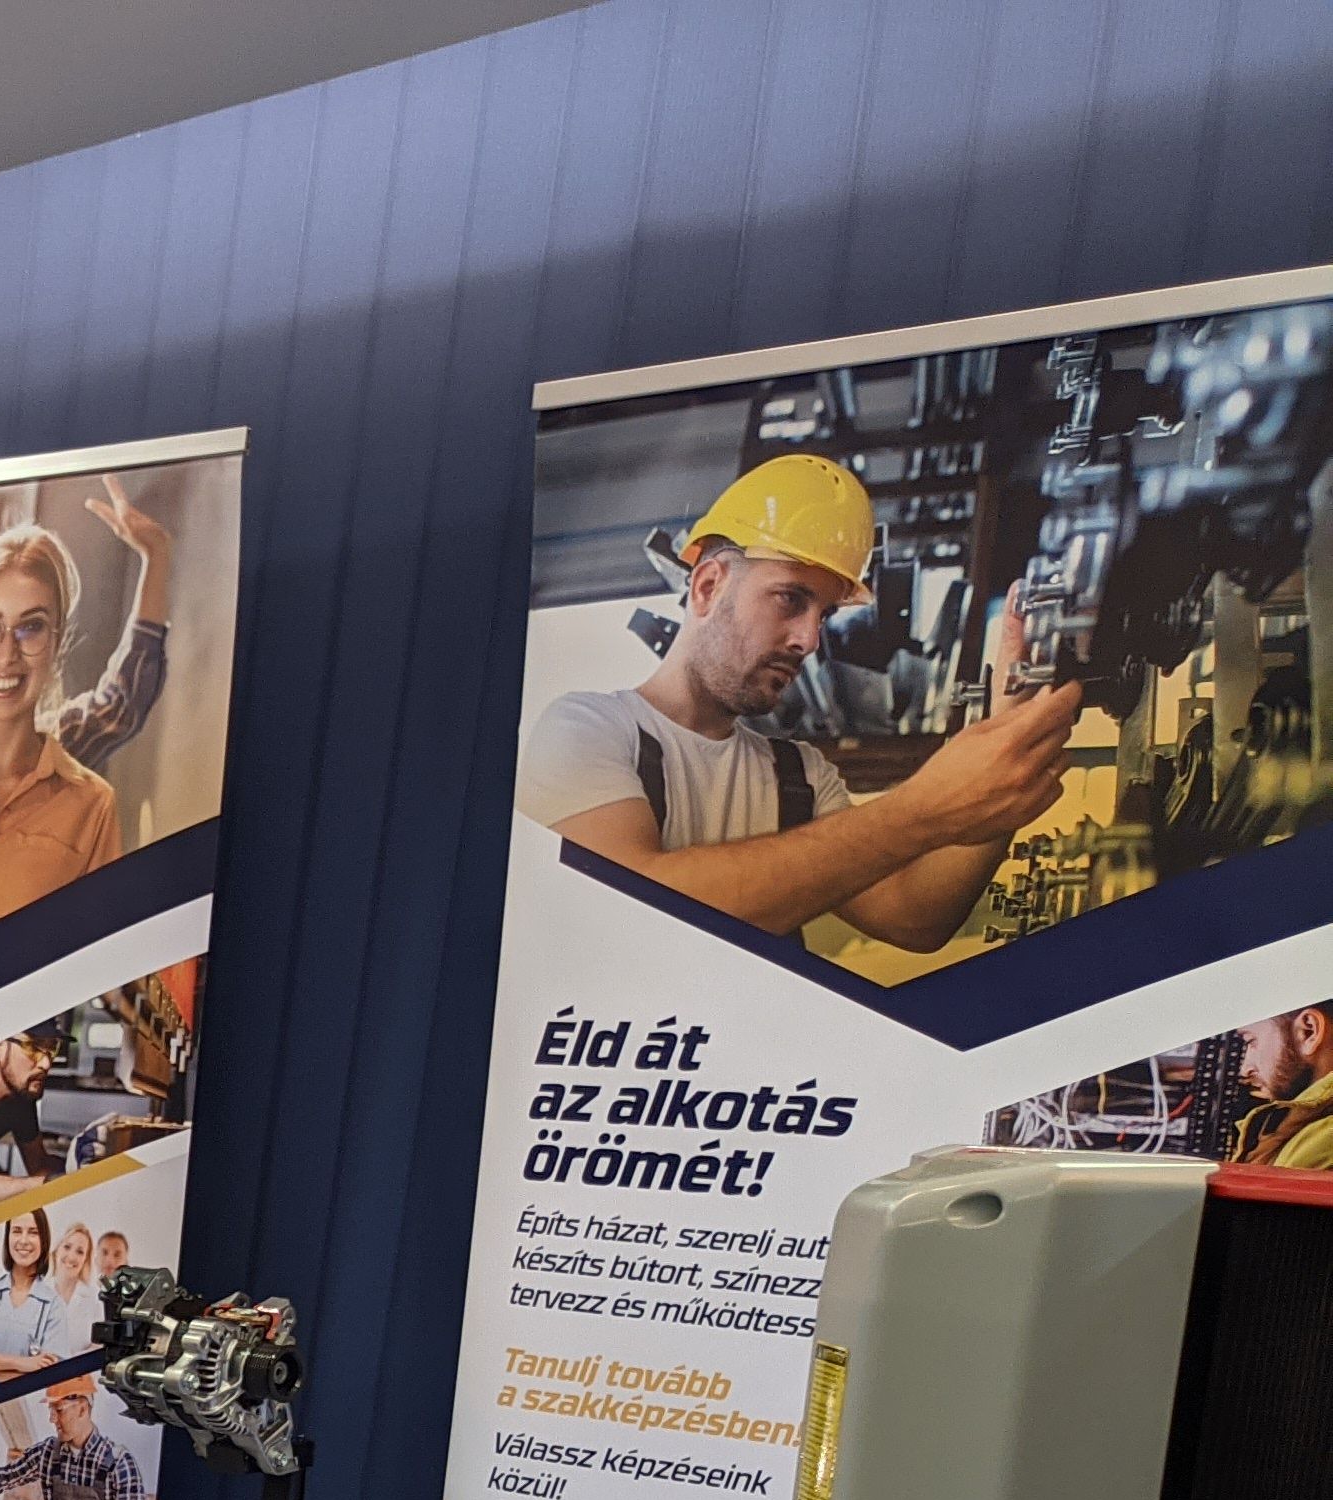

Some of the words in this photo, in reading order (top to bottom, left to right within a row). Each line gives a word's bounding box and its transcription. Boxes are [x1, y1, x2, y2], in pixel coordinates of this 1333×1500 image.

[535, 1005, 632, 1069] Éld
[634, 1016, 709, 1071] át
[528, 1083, 601, 1122] az
[607, 1078, 858, 1137] alkotás
[522, 1129, 775, 1198] örömét!
[516, 1205, 580, 1240] Építs
[584, 1215, 669, 1249] házat,
[675, 1226, 775, 1257] szerelj
[776, 1234, 830, 1260] aut
[513, 1245, 604, 1278] készíts
[609, 1256, 704, 1290] bútort,
[710, 1265, 822, 1299] színezz
[509, 1282, 604, 1315] tervezz
[611, 1292, 645, 1319] és
[651, 1297, 816, 1338] működtess
[505, 1348, 602, 1386] Tanulj
[606, 1359, 732, 1400] tovább
[497, 1387, 514, 1408] a
[521, 1385, 804, 1448] szakképzésben!
[487, 1467, 567, 1500] közül!
[493, 1431, 596, 1470] Válassz
[601, 1446, 773, 1497] képzéseink
